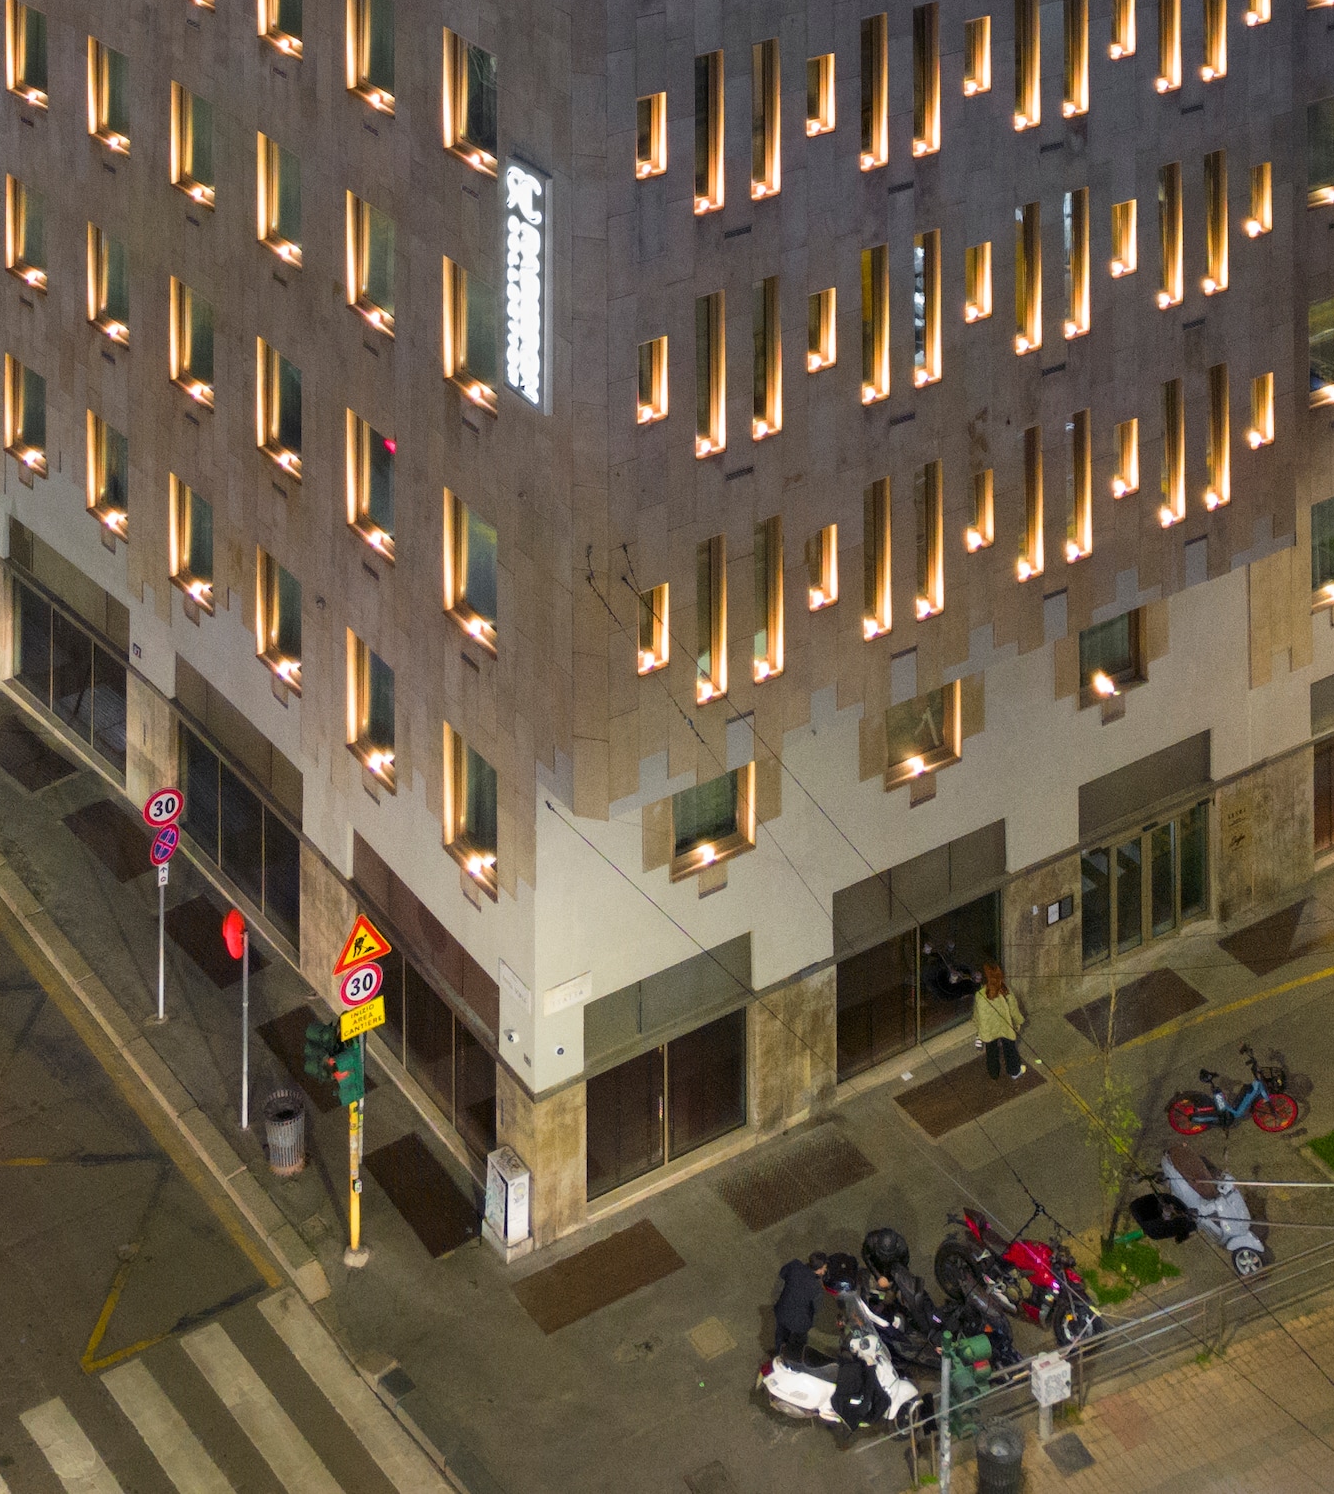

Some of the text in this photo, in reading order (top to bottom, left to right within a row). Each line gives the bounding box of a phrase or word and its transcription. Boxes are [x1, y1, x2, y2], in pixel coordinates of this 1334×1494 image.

[153, 797, 176, 818] 30
[350, 972, 374, 997] 30
[350, 1004, 375, 1019] INIZIO
[352, 1011, 373, 1025] AREA
[343, 1015, 383, 1037] CANTIERE
